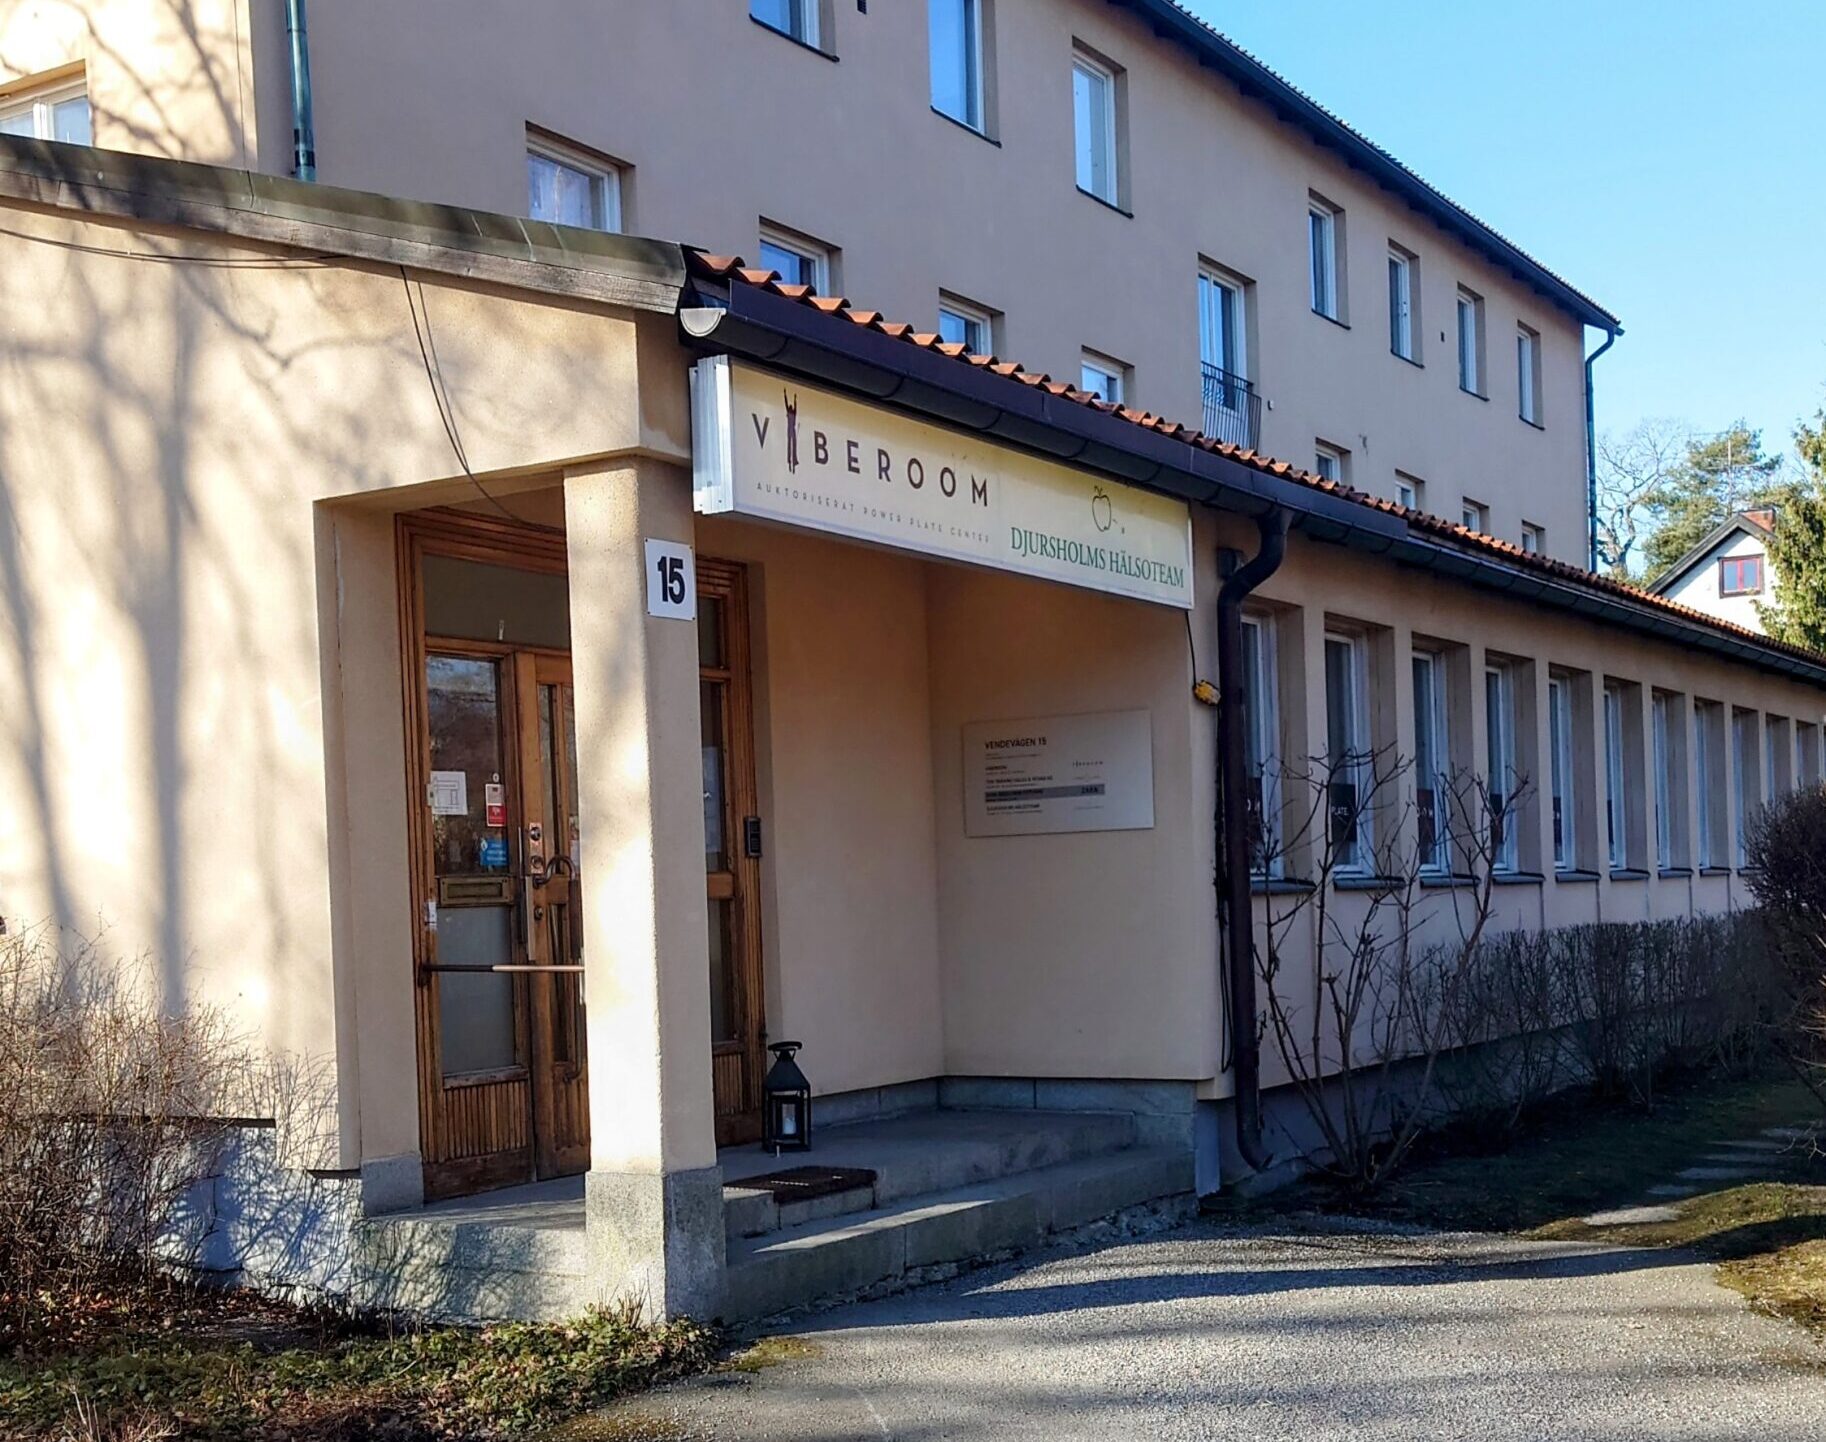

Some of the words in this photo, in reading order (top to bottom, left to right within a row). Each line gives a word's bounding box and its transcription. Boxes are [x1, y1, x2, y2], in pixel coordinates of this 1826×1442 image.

[756, 482, 855, 512] AUKTORISERAT
[863, 506, 902, 523] POWER
[909, 516, 943, 533] PLATE
[950, 526, 990, 544] CENTER
[657, 555, 686, 605] 15
[1011, 527, 1106, 570] DJURSHOLMS
[1109, 550, 1184, 589] HÄLSOTEAM
[1038, 736, 1047, 746] 15
